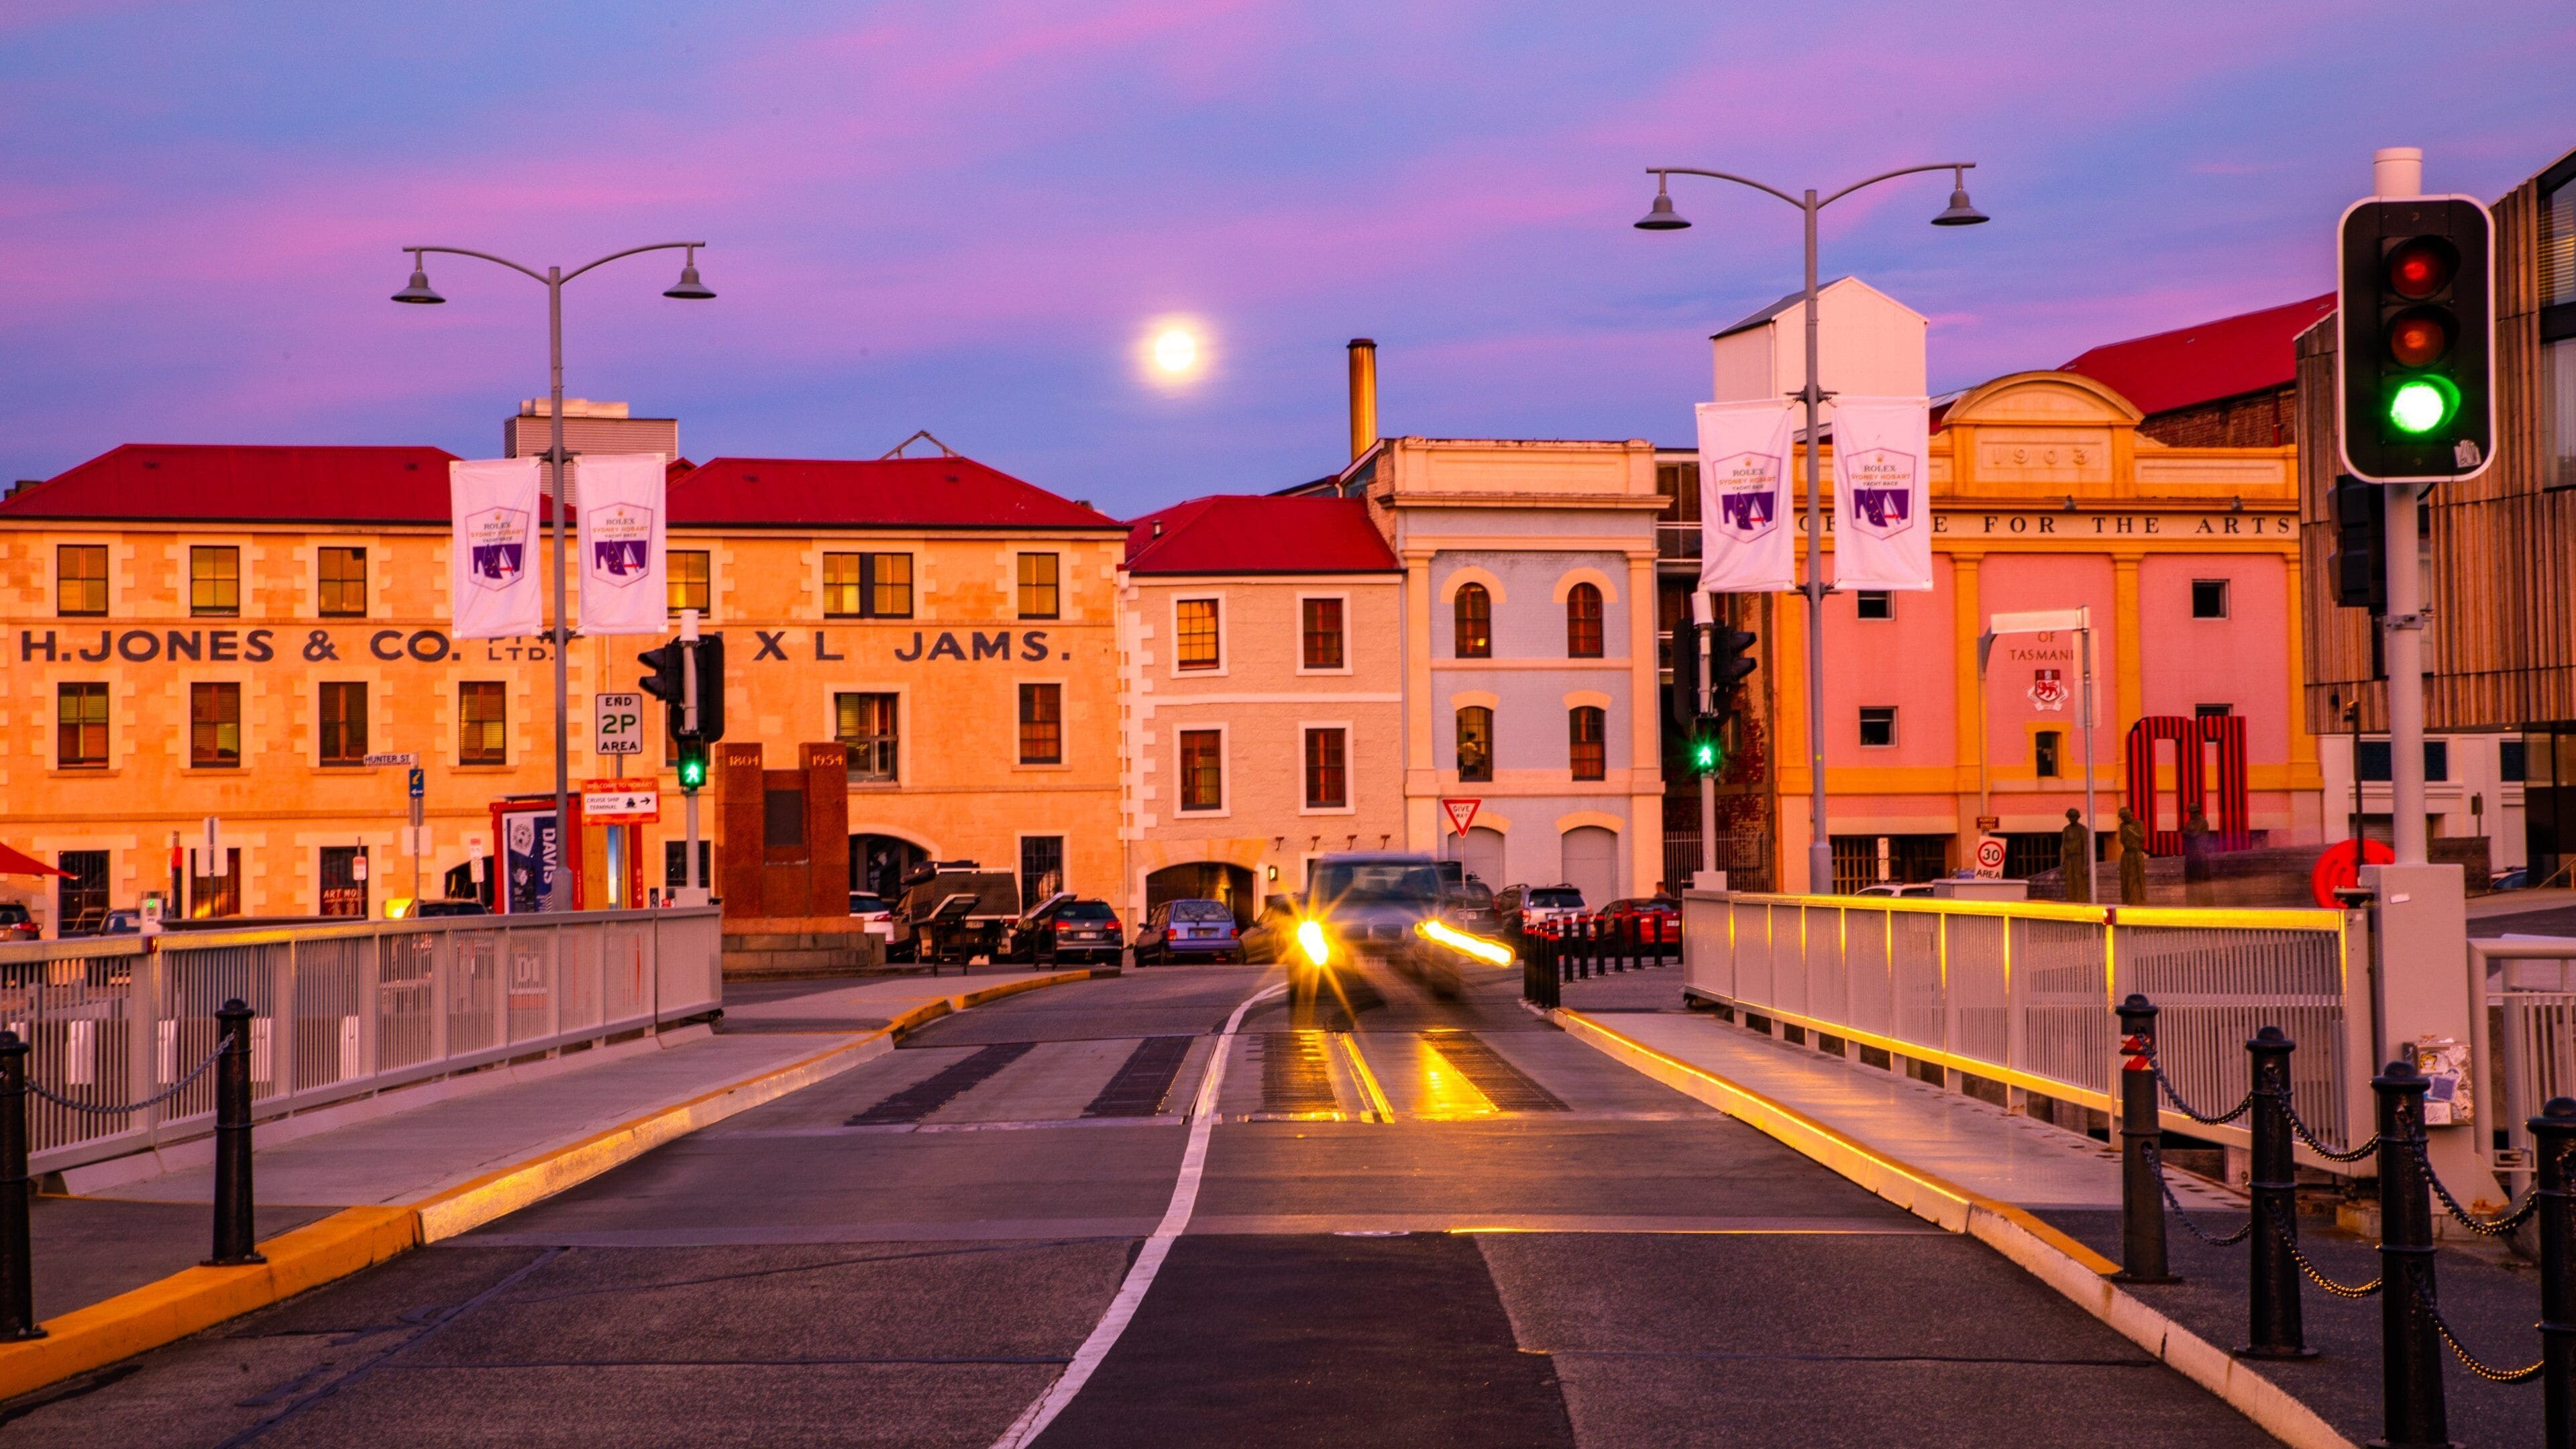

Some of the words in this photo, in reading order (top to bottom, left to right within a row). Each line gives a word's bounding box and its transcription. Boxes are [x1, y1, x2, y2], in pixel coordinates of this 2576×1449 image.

[1992, 449, 2088, 465] 1903
[1984, 516, 2055, 533] FOR
[2092, 517, 2159, 533] THE
[2196, 518, 2290, 533] ARTS
[2037, 631, 2055, 643] OF
[21, 629, 274, 662] H.JONES
[303, 629, 340, 662] &
[370, 629, 461, 663] CO.
[894, 631, 1071, 661] JAMS.
[488, 647, 554, 661] LTD.
[605, 697, 633, 706] END
[602, 714, 637, 734] 2P
[601, 741, 637, 751] AREA
[365, 755, 398, 763] HUNTER
[400, 754, 410, 763] ST
[729, 755, 759, 766] 1804
[813, 754, 843, 766] 1954
[542, 828, 557, 885] DAVIS
[1982, 848, 2000, 861] 30
[1976, 869, 2000, 879] AREA
[323, 888, 343, 899] ART
